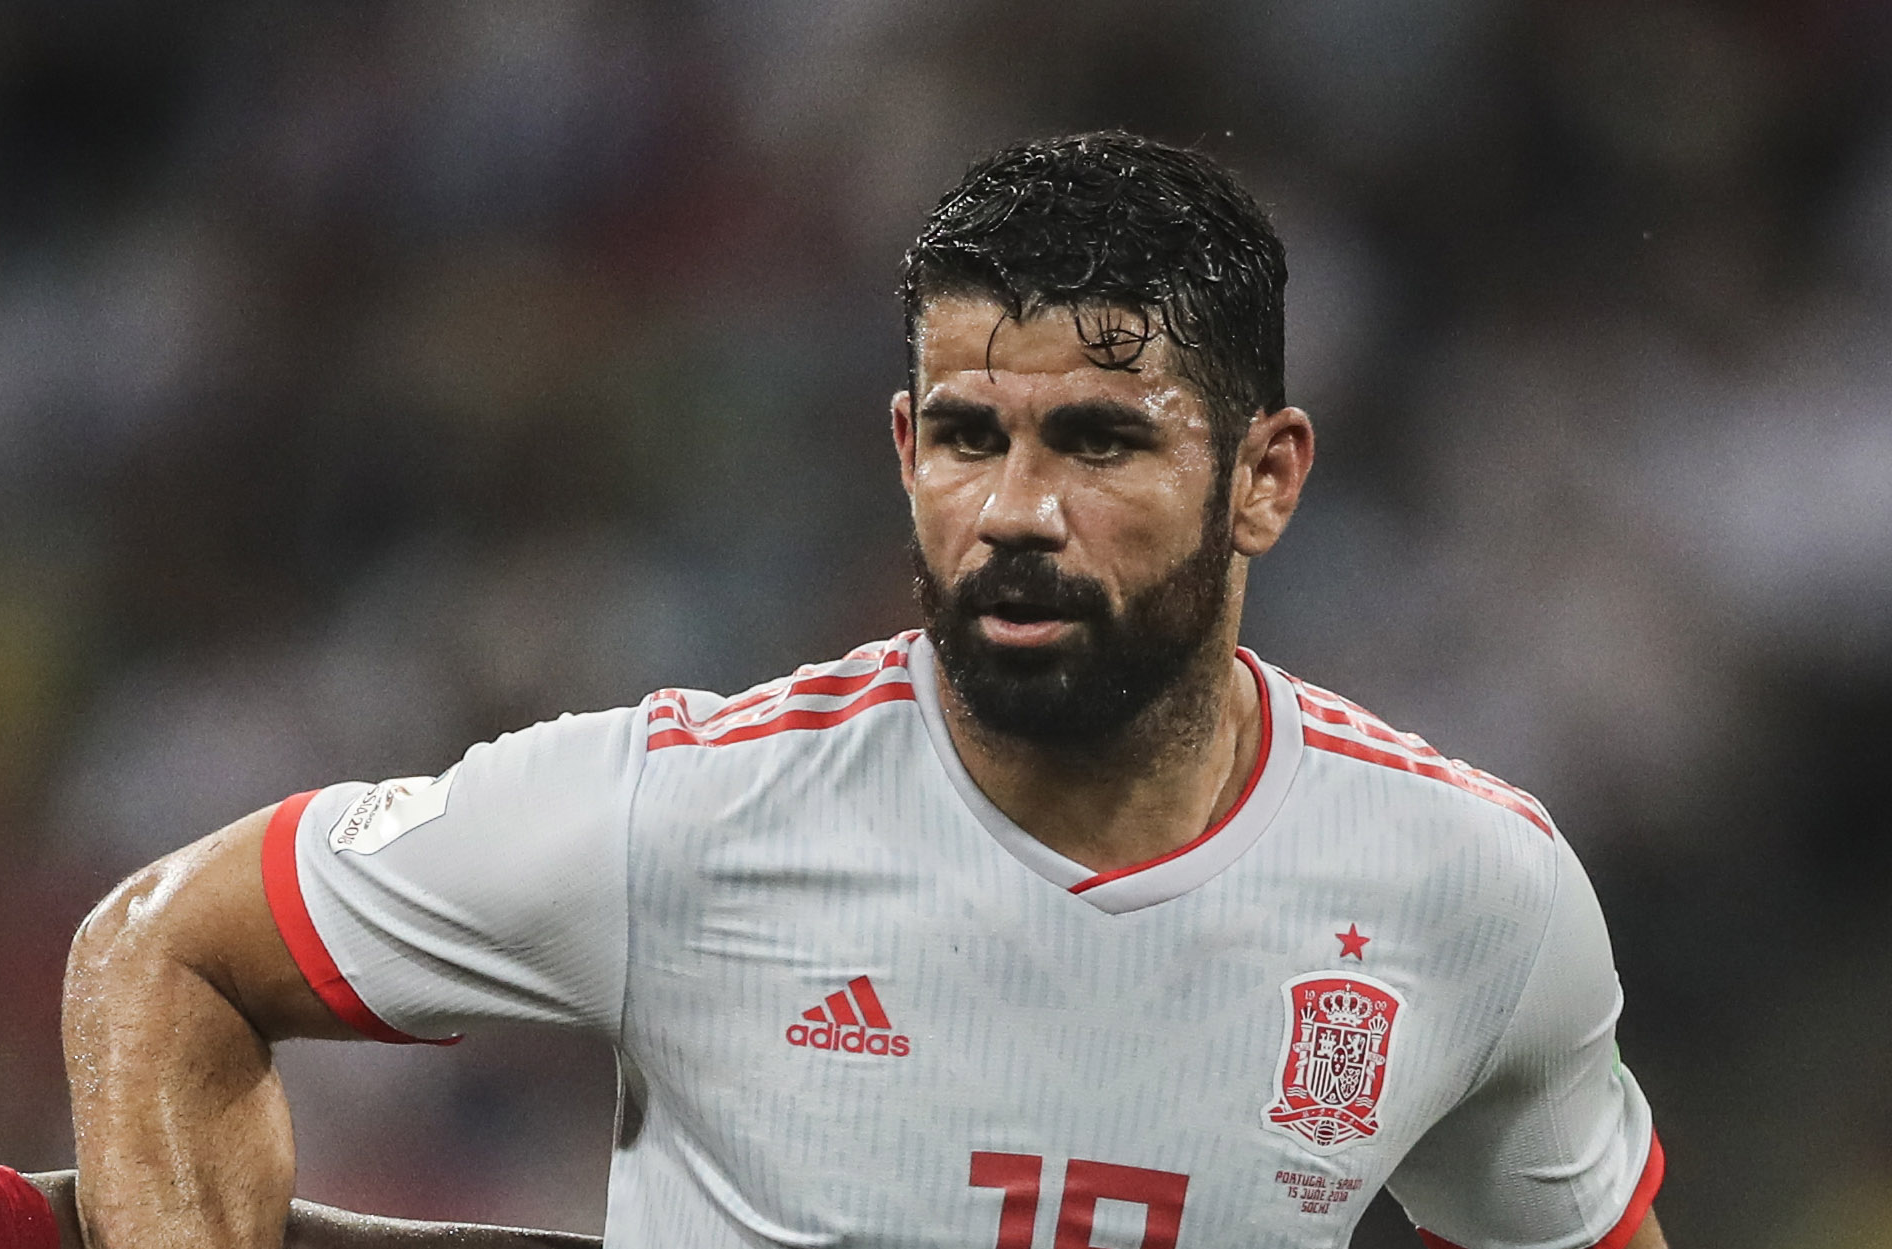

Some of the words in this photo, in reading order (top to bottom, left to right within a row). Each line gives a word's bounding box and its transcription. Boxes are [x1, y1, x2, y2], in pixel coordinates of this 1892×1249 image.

[785, 1022, 911, 1058] adidas
[1275, 1170, 1326, 1189] PORTUGAL
[1288, 1186, 1298, 1198] 15
[1300, 1188, 1326, 1201] JUNE
[1301, 1201, 1330, 1214] SOCHI
